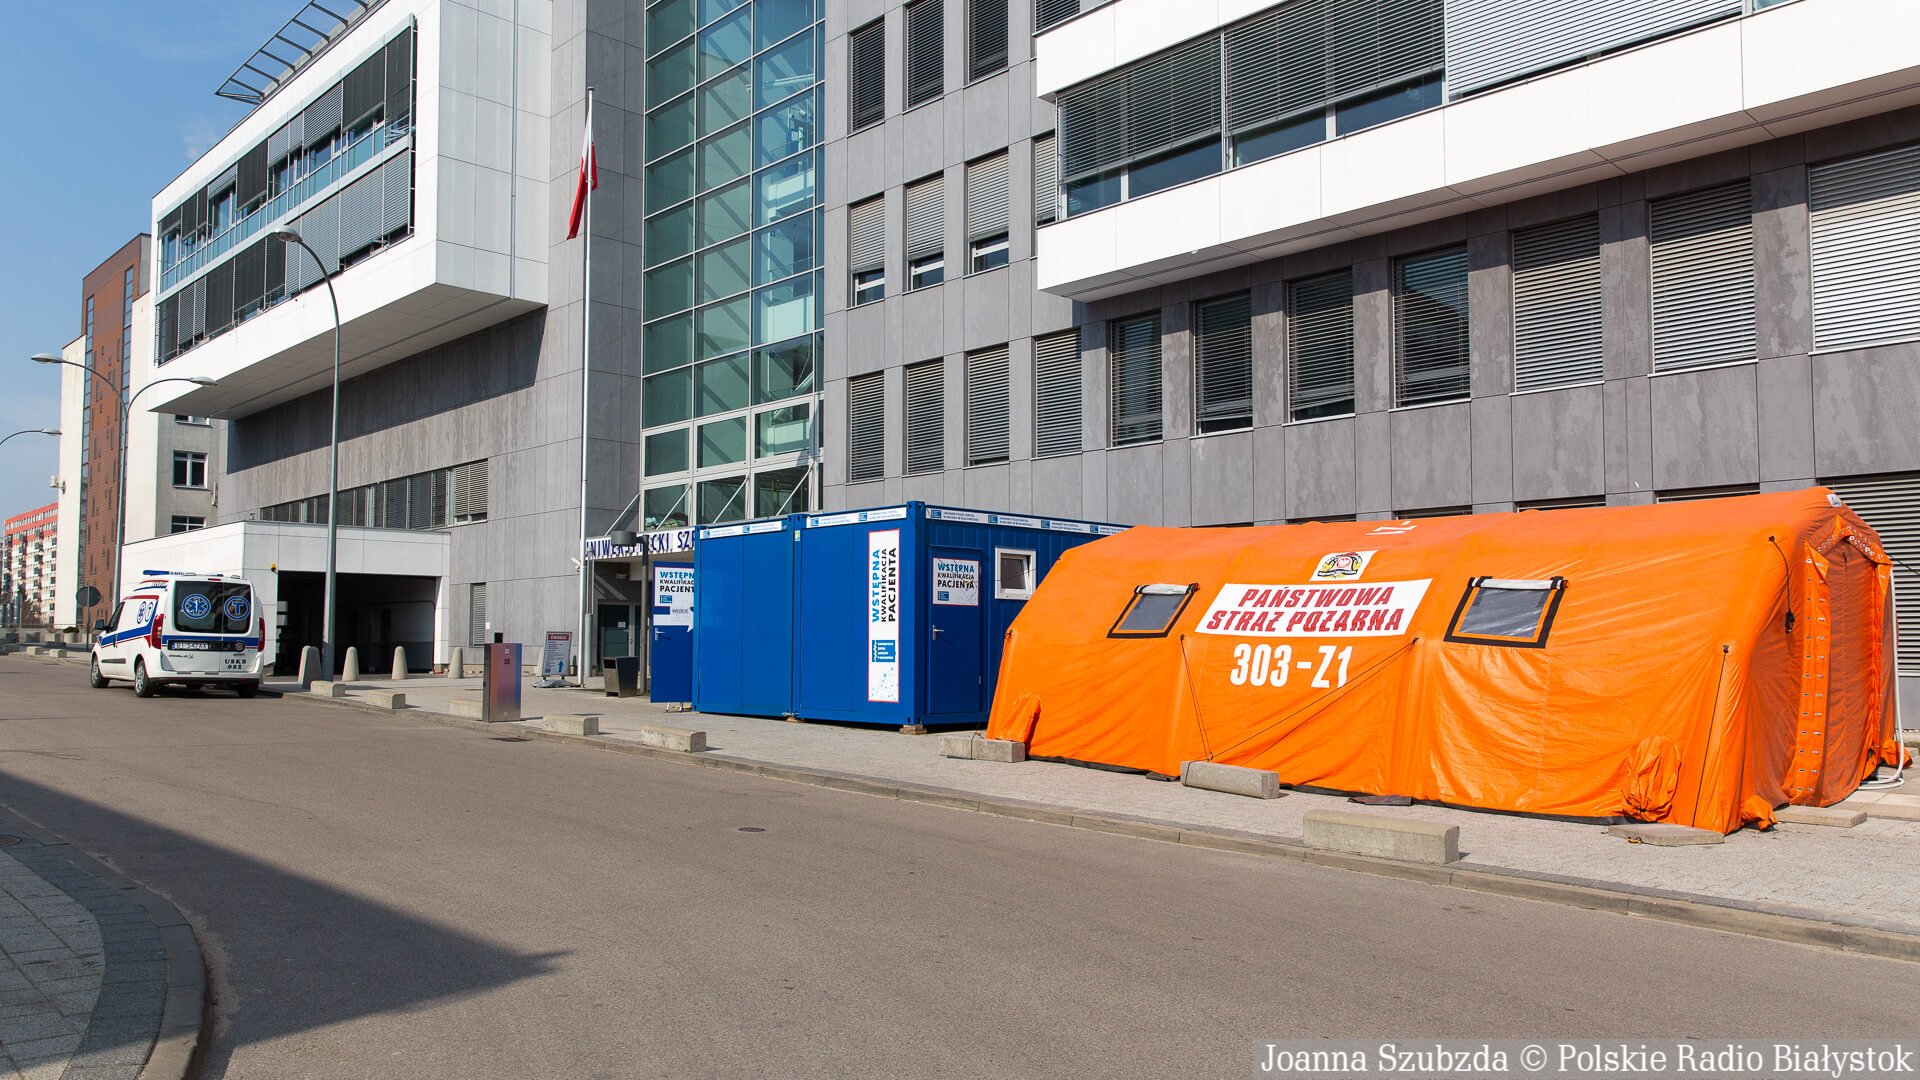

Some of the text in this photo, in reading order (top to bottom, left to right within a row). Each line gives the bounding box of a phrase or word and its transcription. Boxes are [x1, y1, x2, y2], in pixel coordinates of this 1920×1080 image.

[937, 562, 975, 574] WSTĘPNA
[937, 572, 975, 580] KWALIFIKACJA
[872, 549, 882, 623] WSTĘPNA
[888, 547, 897, 622] PACJENTA
[937, 579, 975, 589] PACJENTA
[1238, 586, 1395, 608] PAŃSTWOWA
[1206, 608, 1404, 632] STRAŻ POŻARNA
[1230, 643, 1353, 688] 303-Z1
